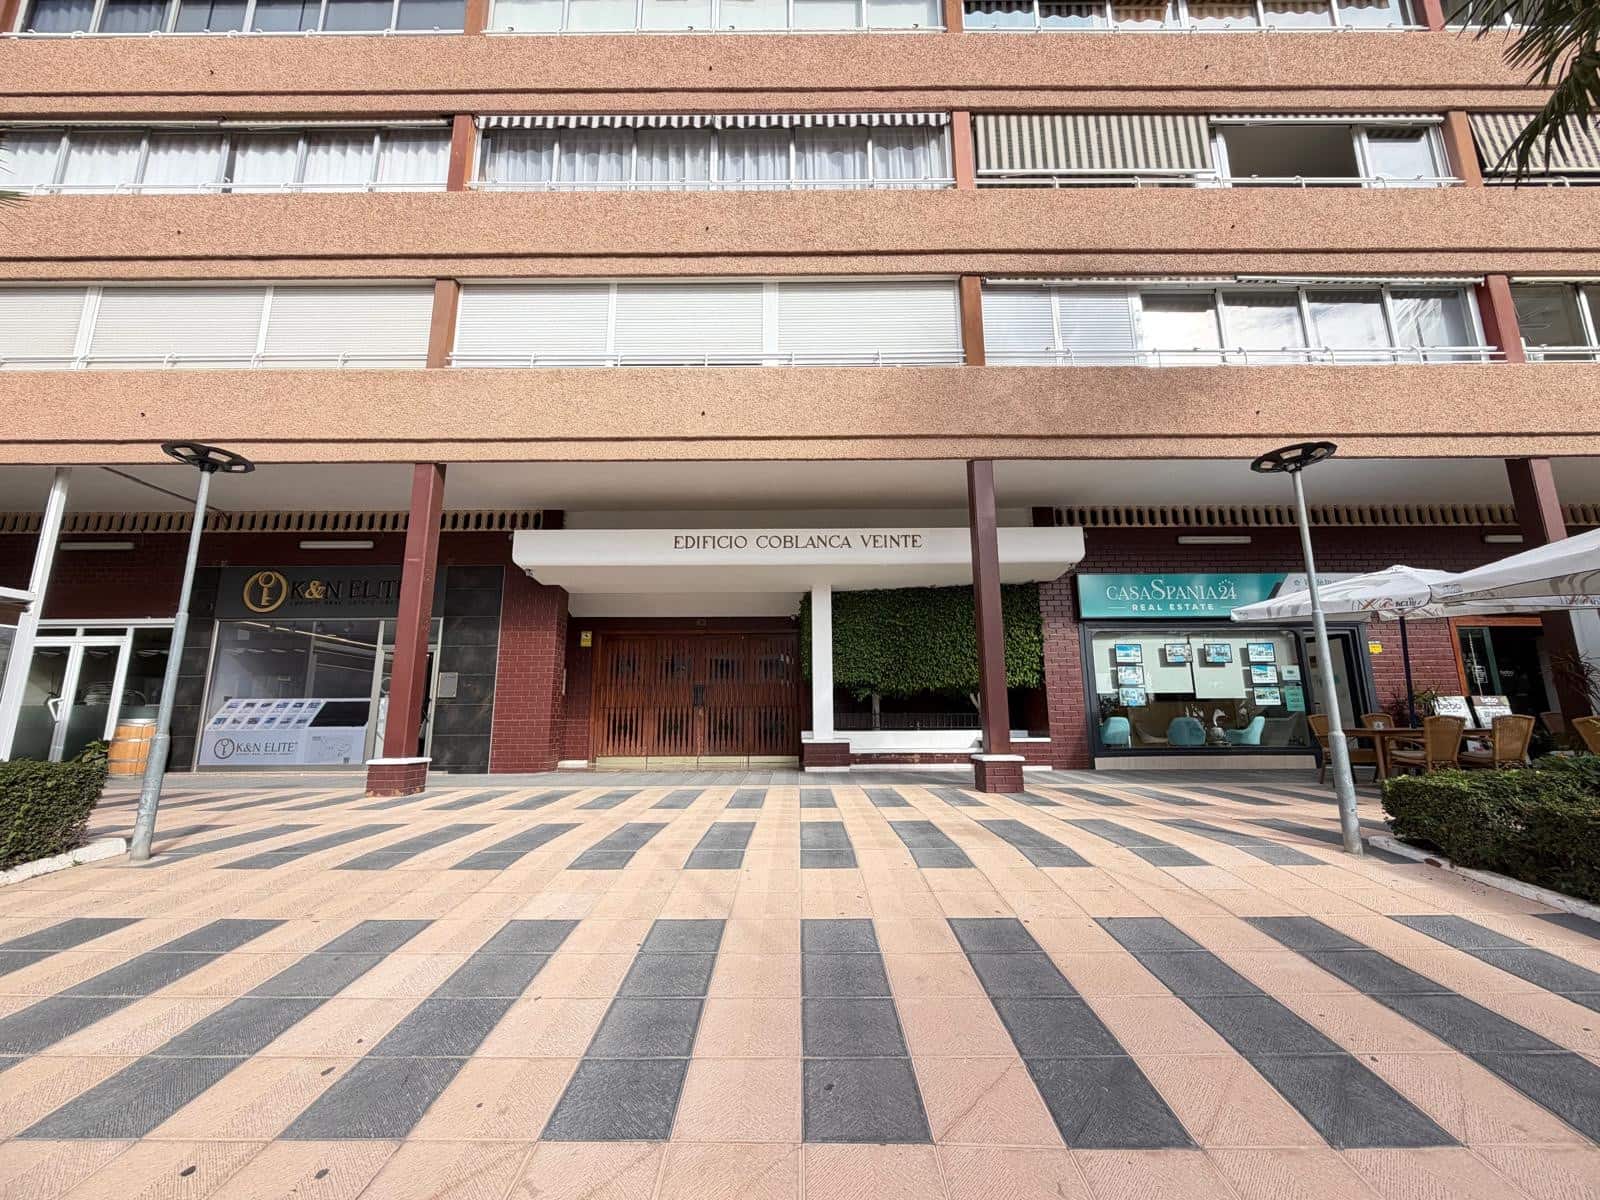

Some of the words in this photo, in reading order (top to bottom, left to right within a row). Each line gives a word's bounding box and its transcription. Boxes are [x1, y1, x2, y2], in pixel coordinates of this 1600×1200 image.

[673, 535, 748, 549] EDIFICIO
[756, 535, 851, 549] COBLANCA
[861, 534, 922, 548] VEINTE
[291, 579, 341, 599] K&N
[1131, 603, 1163, 611] REAL
[1169, 603, 1215, 611] ESTATE
[236, 742, 260, 752] K&N
[264, 742, 296, 752] ELITE
